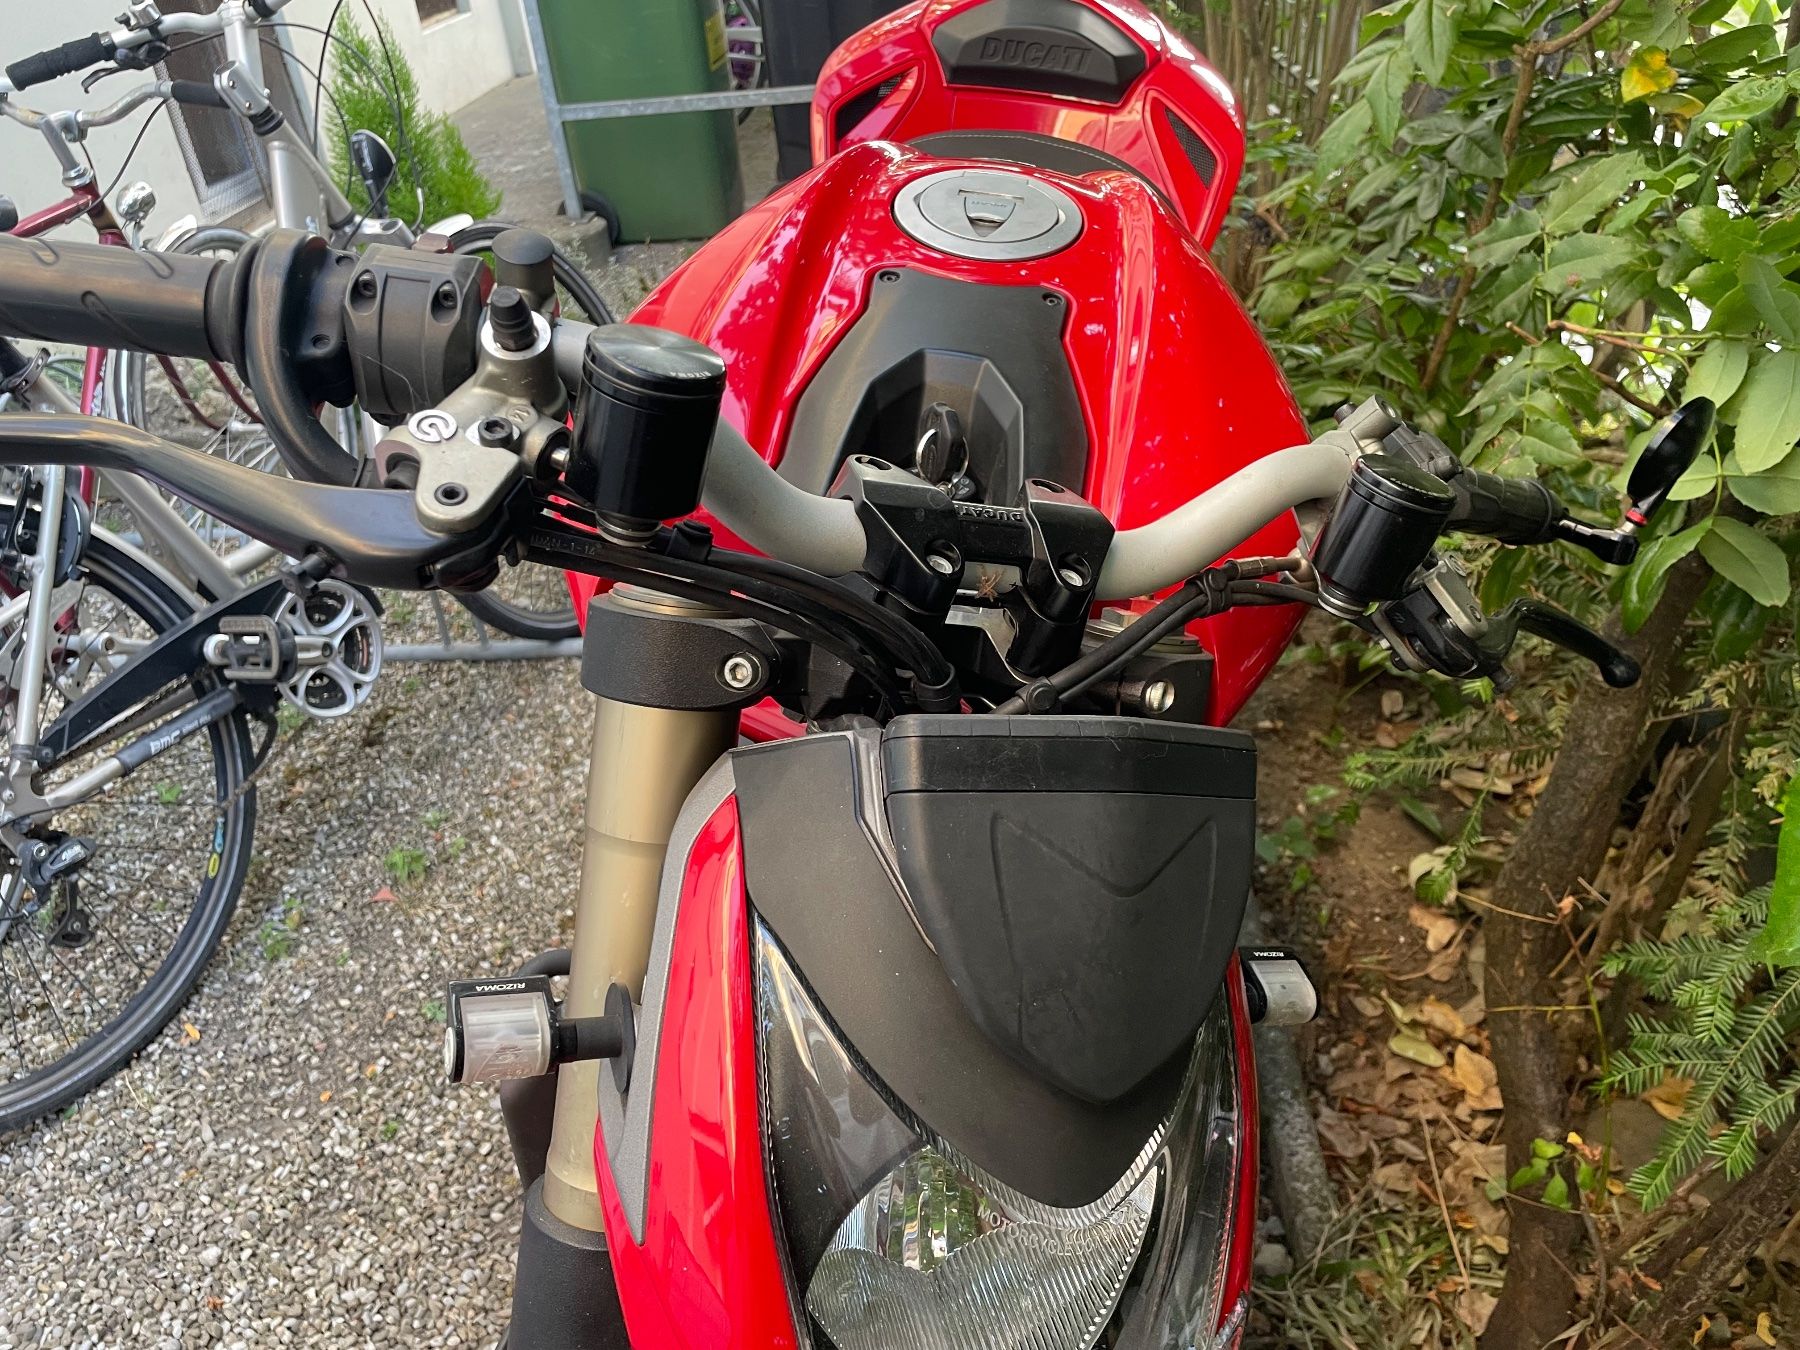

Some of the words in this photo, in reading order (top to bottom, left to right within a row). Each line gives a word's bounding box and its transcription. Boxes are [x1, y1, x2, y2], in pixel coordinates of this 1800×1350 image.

[980, 36, 1093, 74] DUCATI
[475, 982, 526, 992] RIZOMA
[976, 1205, 1073, 1256] MOTORCYCLE
